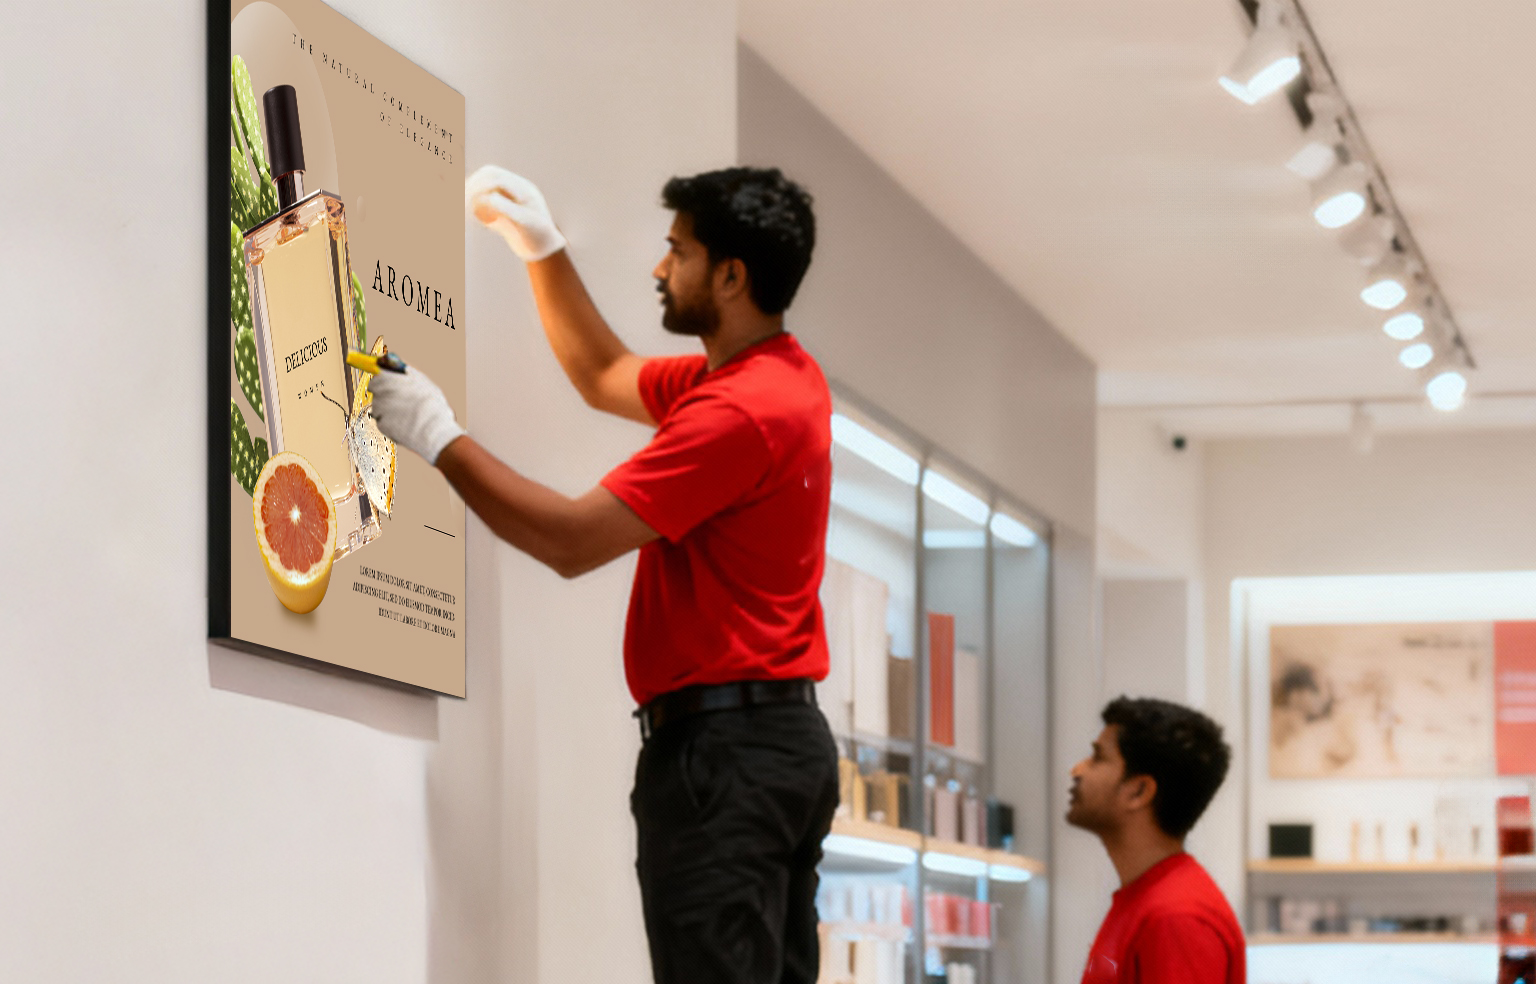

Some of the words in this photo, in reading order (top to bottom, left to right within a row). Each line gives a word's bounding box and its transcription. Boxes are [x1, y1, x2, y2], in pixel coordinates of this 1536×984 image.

[292, 33, 314, 56] THE
[322, 52, 375, 95] NATURAL
[372, 259, 456, 331] AROMEA
[285, 336, 328, 374] DELICIOUS
